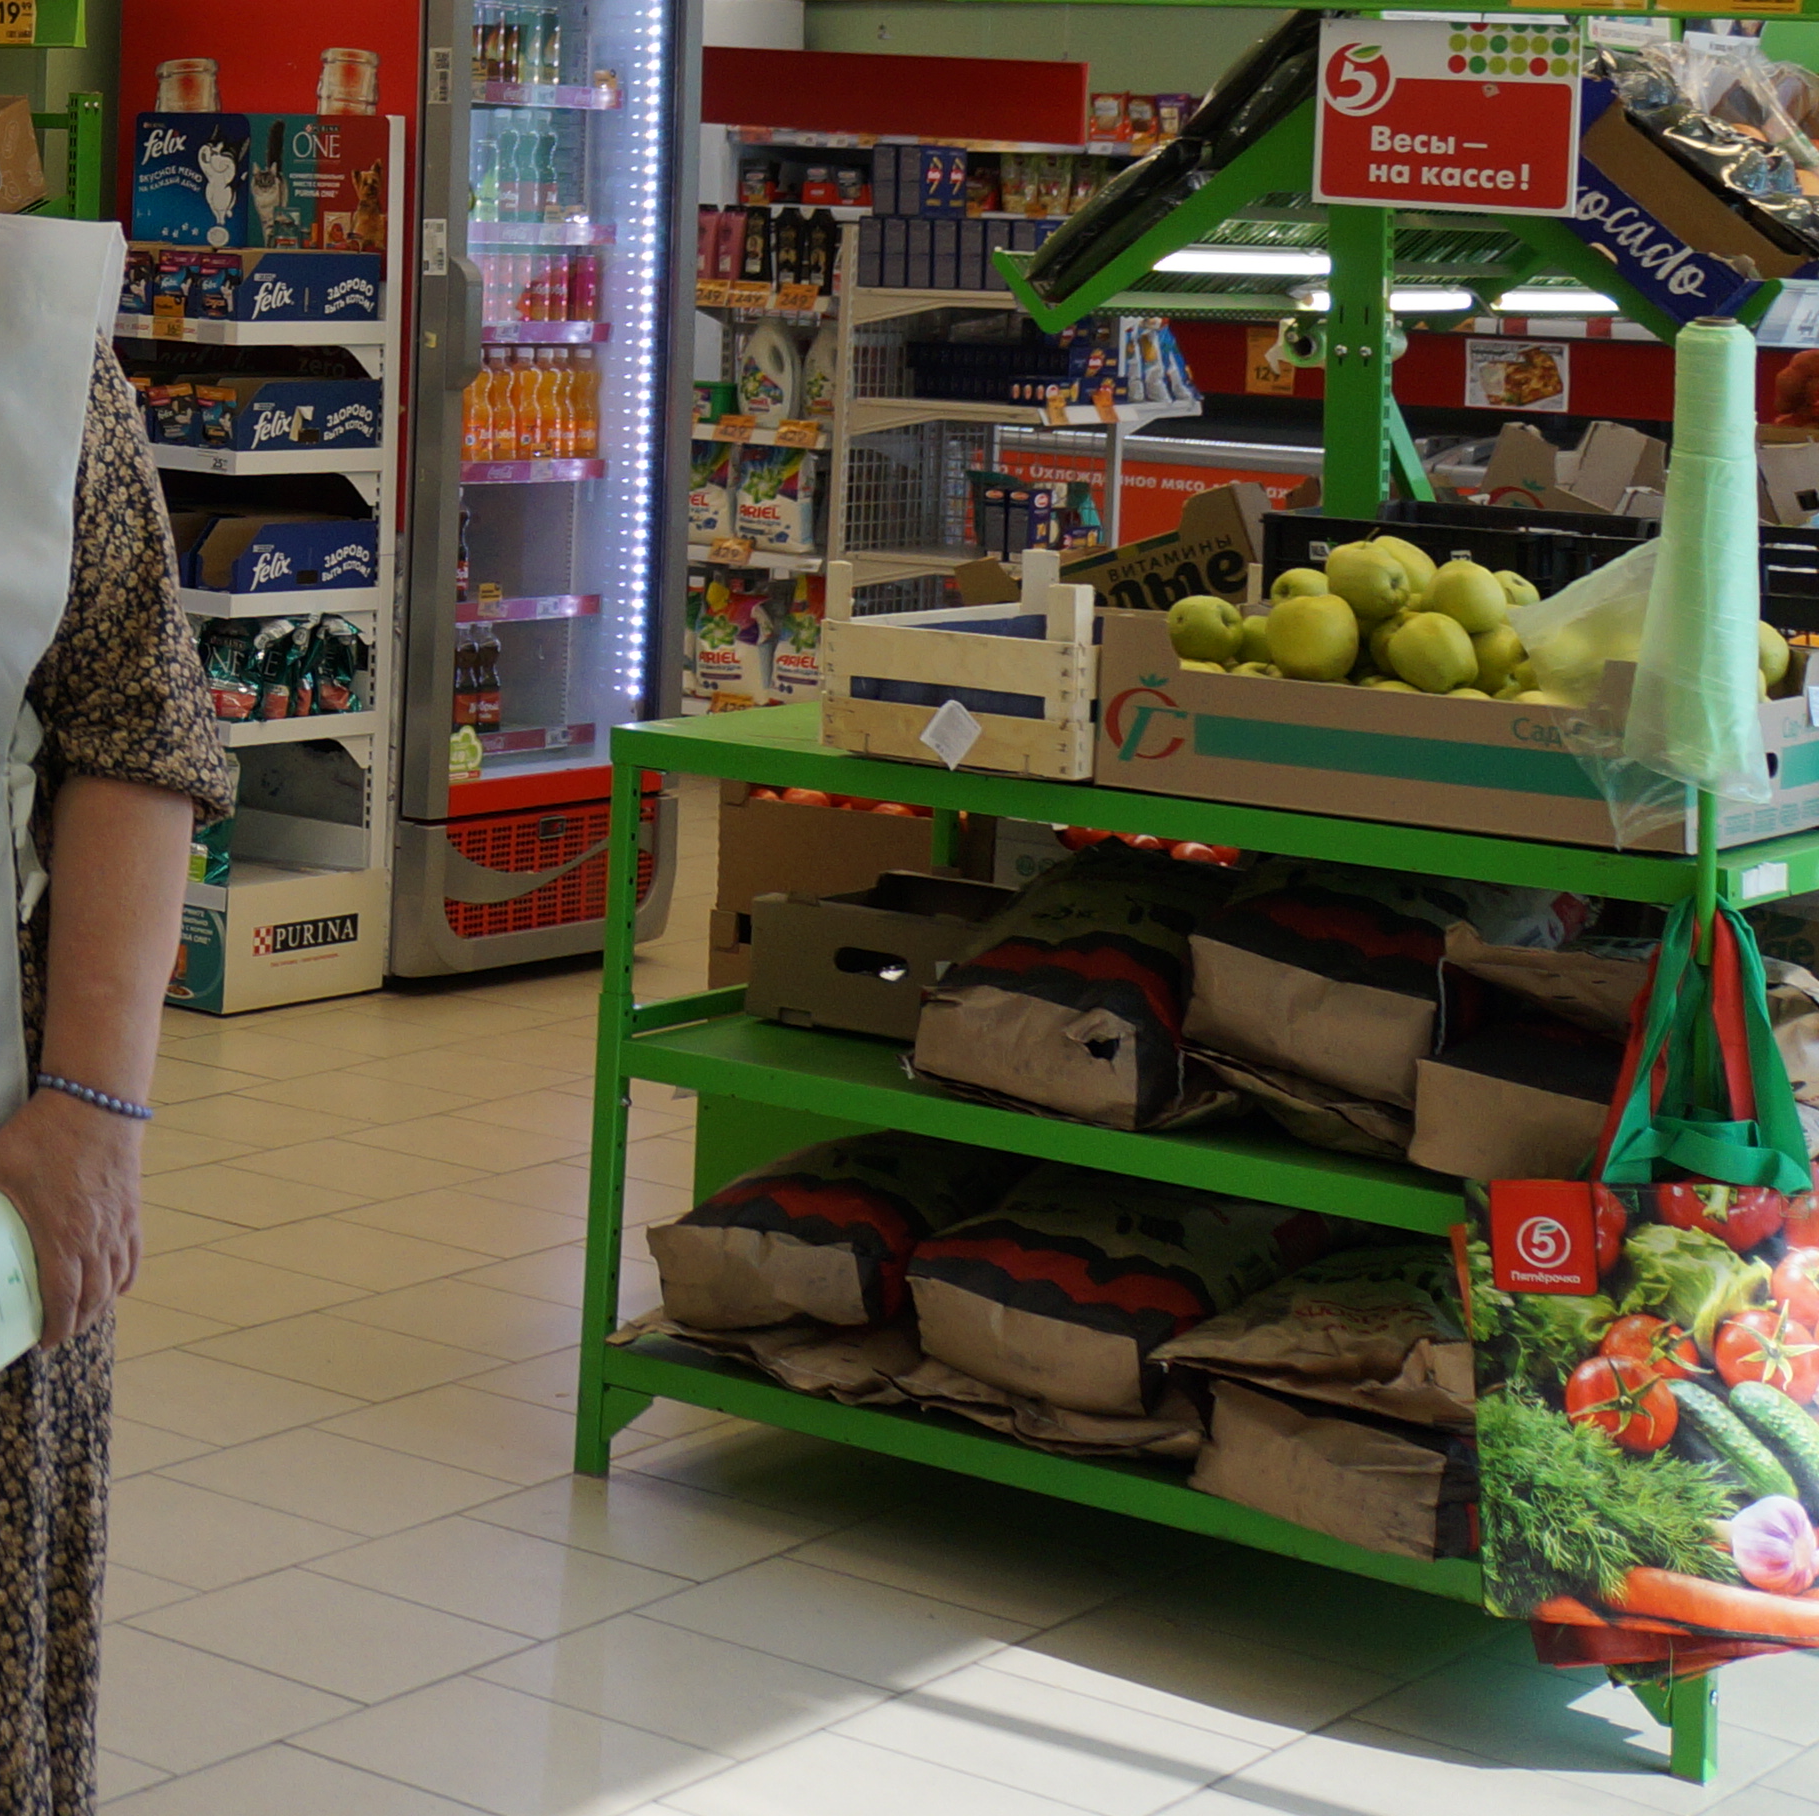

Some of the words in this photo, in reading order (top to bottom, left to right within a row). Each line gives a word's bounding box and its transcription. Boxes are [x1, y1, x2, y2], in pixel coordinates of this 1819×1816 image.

[141, 128, 187, 167] felix
[292, 131, 341, 159] ONE
[1369, 125, 1456, 156] Весы
[1368, 164, 1411, 184] на
[1420, 163, 1530, 192] кассе!
[251, 280, 294, 321] felix
[326, 276, 374, 301] ЗДОРОВО
[251, 406, 292, 448] felix
[325, 405, 374, 429] ЗДОРОВО
[1160, 477, 1207, 492] мясо
[739, 504, 781, 521] ARIEL
[322, 542, 370, 568] ЗДОРОВО
[1107, 534, 1233, 583] ВИТАМИНЫ
[249, 552, 293, 591] felix
[698, 650, 741, 665] ARIEL
[776, 654, 819, 670] ARIEL
[274, 917, 357, 949] PURINA
[1510, 1270, 1581, 1285] Пятёрочка
